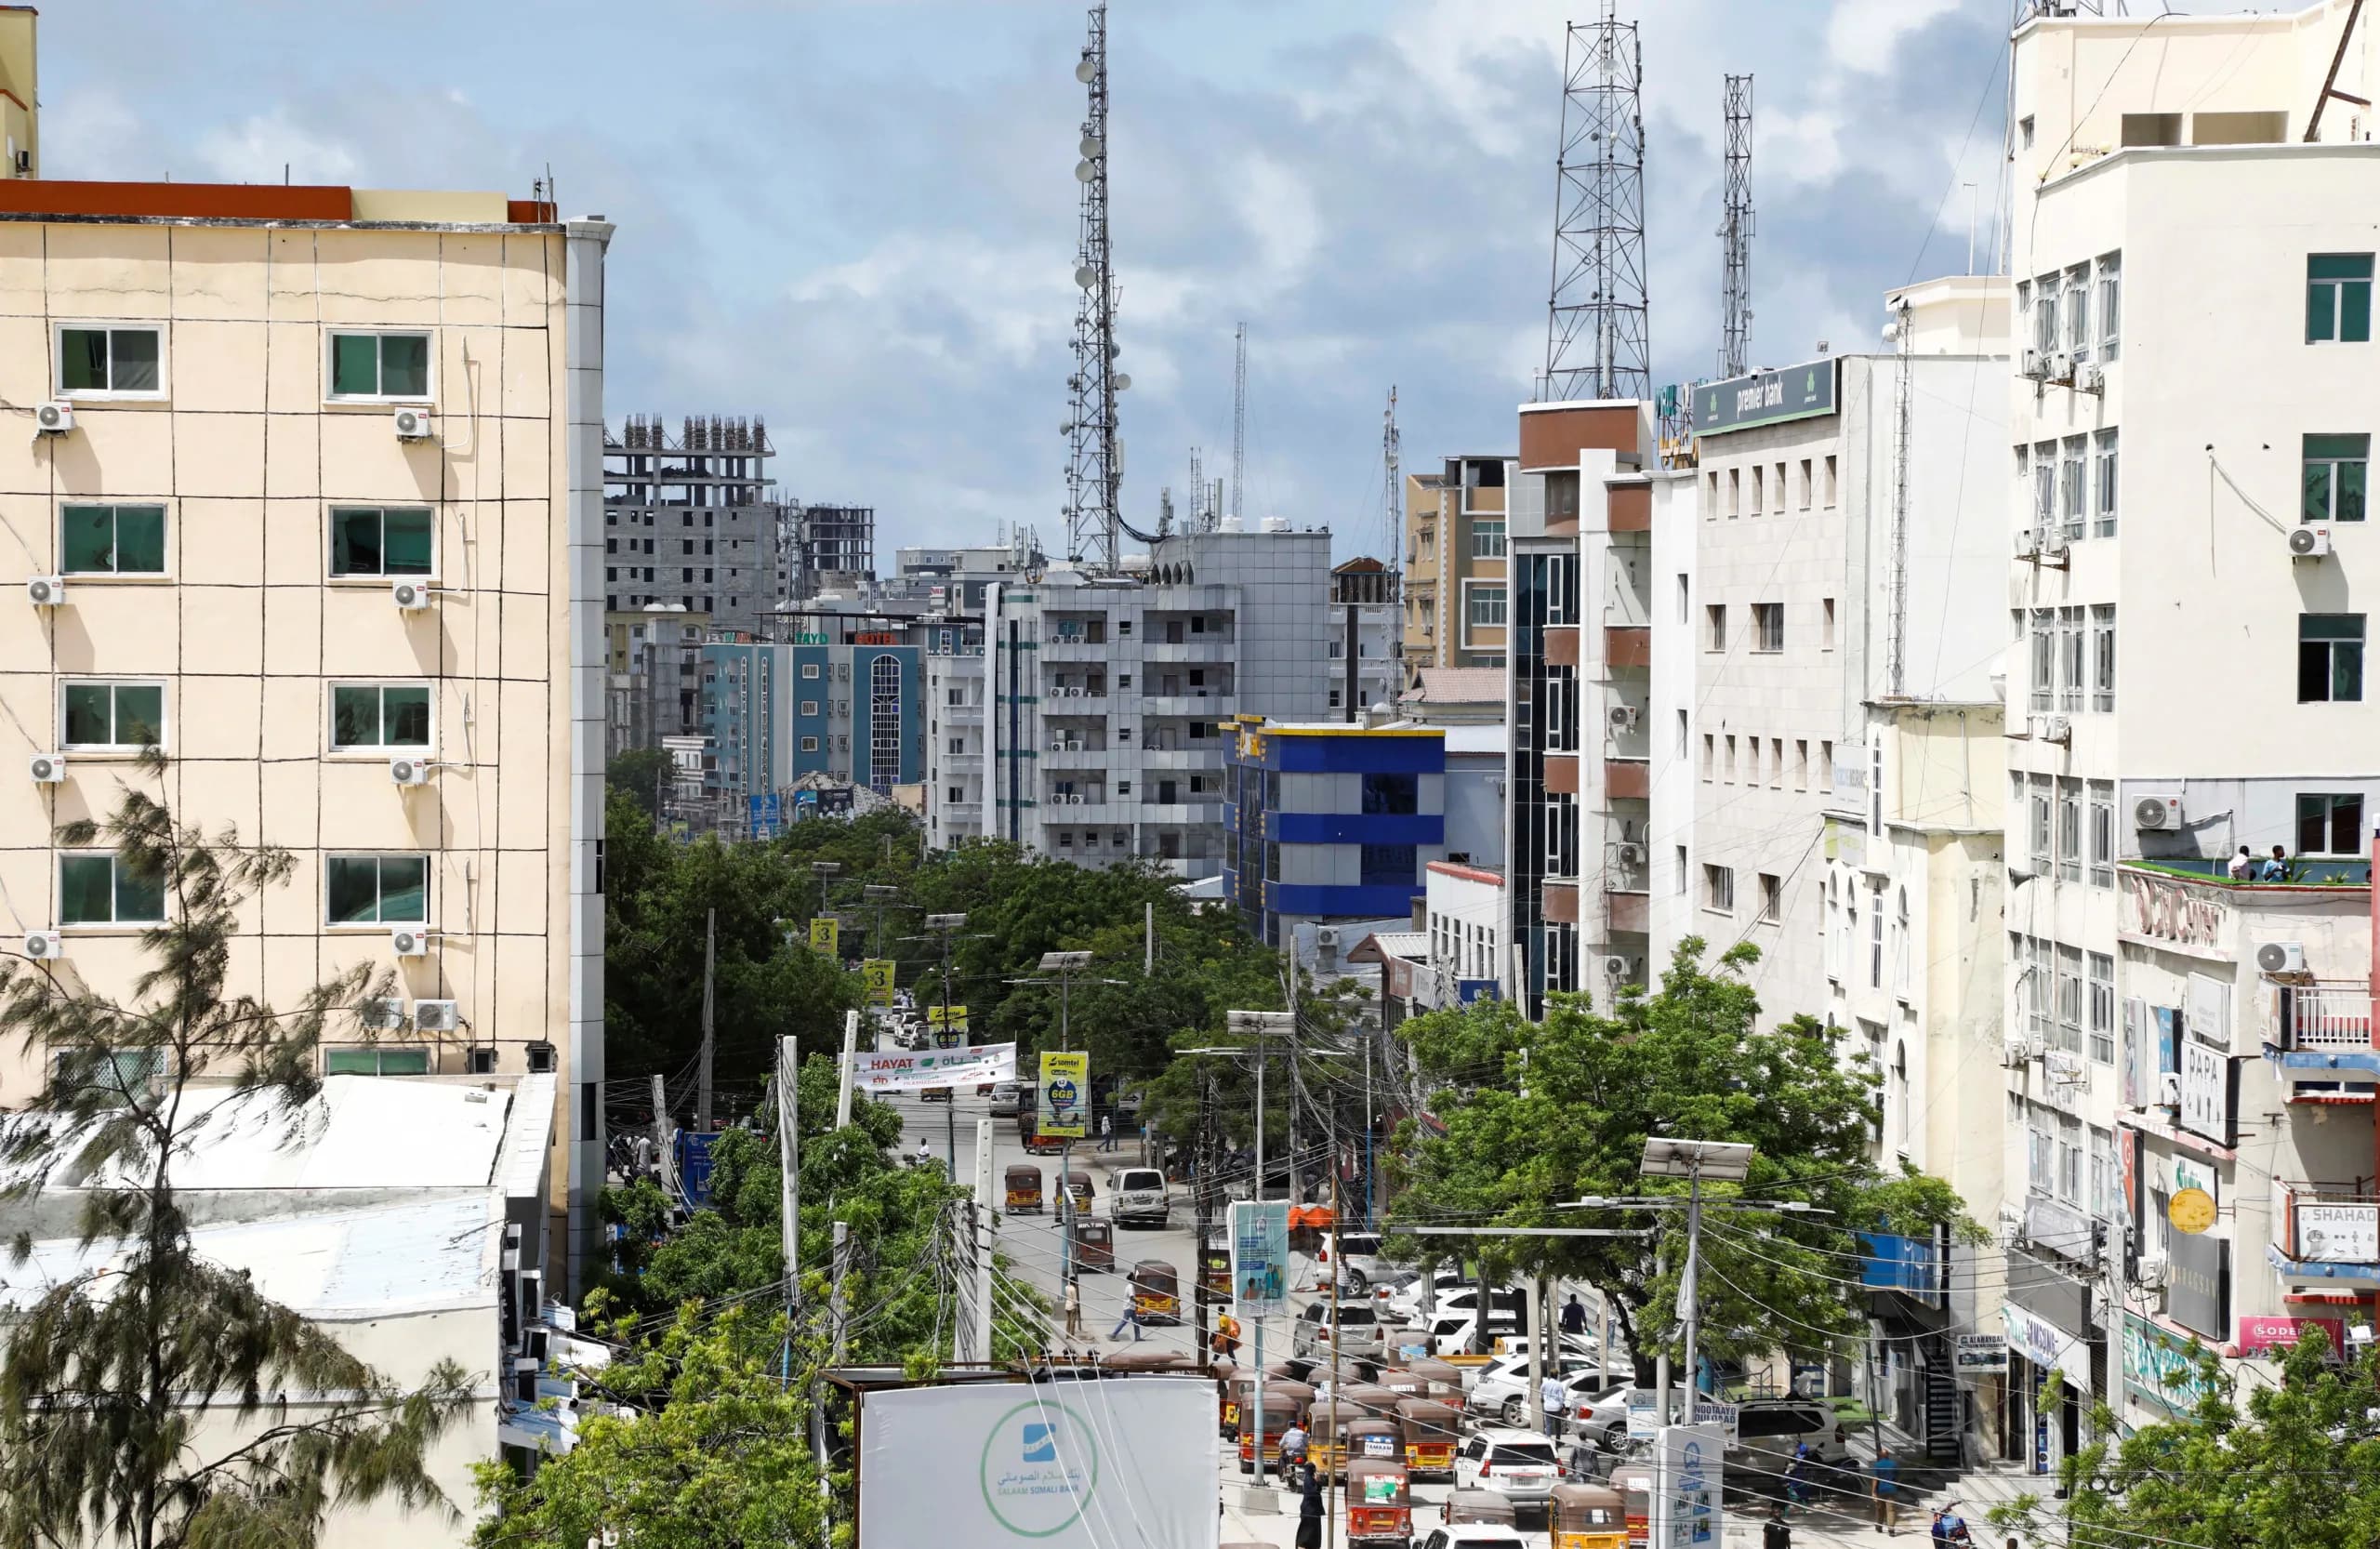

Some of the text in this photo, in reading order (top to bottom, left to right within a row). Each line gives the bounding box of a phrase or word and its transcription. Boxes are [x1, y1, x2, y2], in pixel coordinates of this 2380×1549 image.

[1737, 374, 1783, 420] premier bank
[794, 631, 898, 644] TAYO HOTEL
[871, 1058, 914, 1069] HAYAT
[2189, 1047, 2218, 1085] PAPA
[1051, 1090, 1074, 1099] 6GB
[2313, 1209, 2376, 1222] SHAHAD
[1030, 1486, 1058, 1495] SOMALI
[1059, 1485, 1079, 1494] BANK
